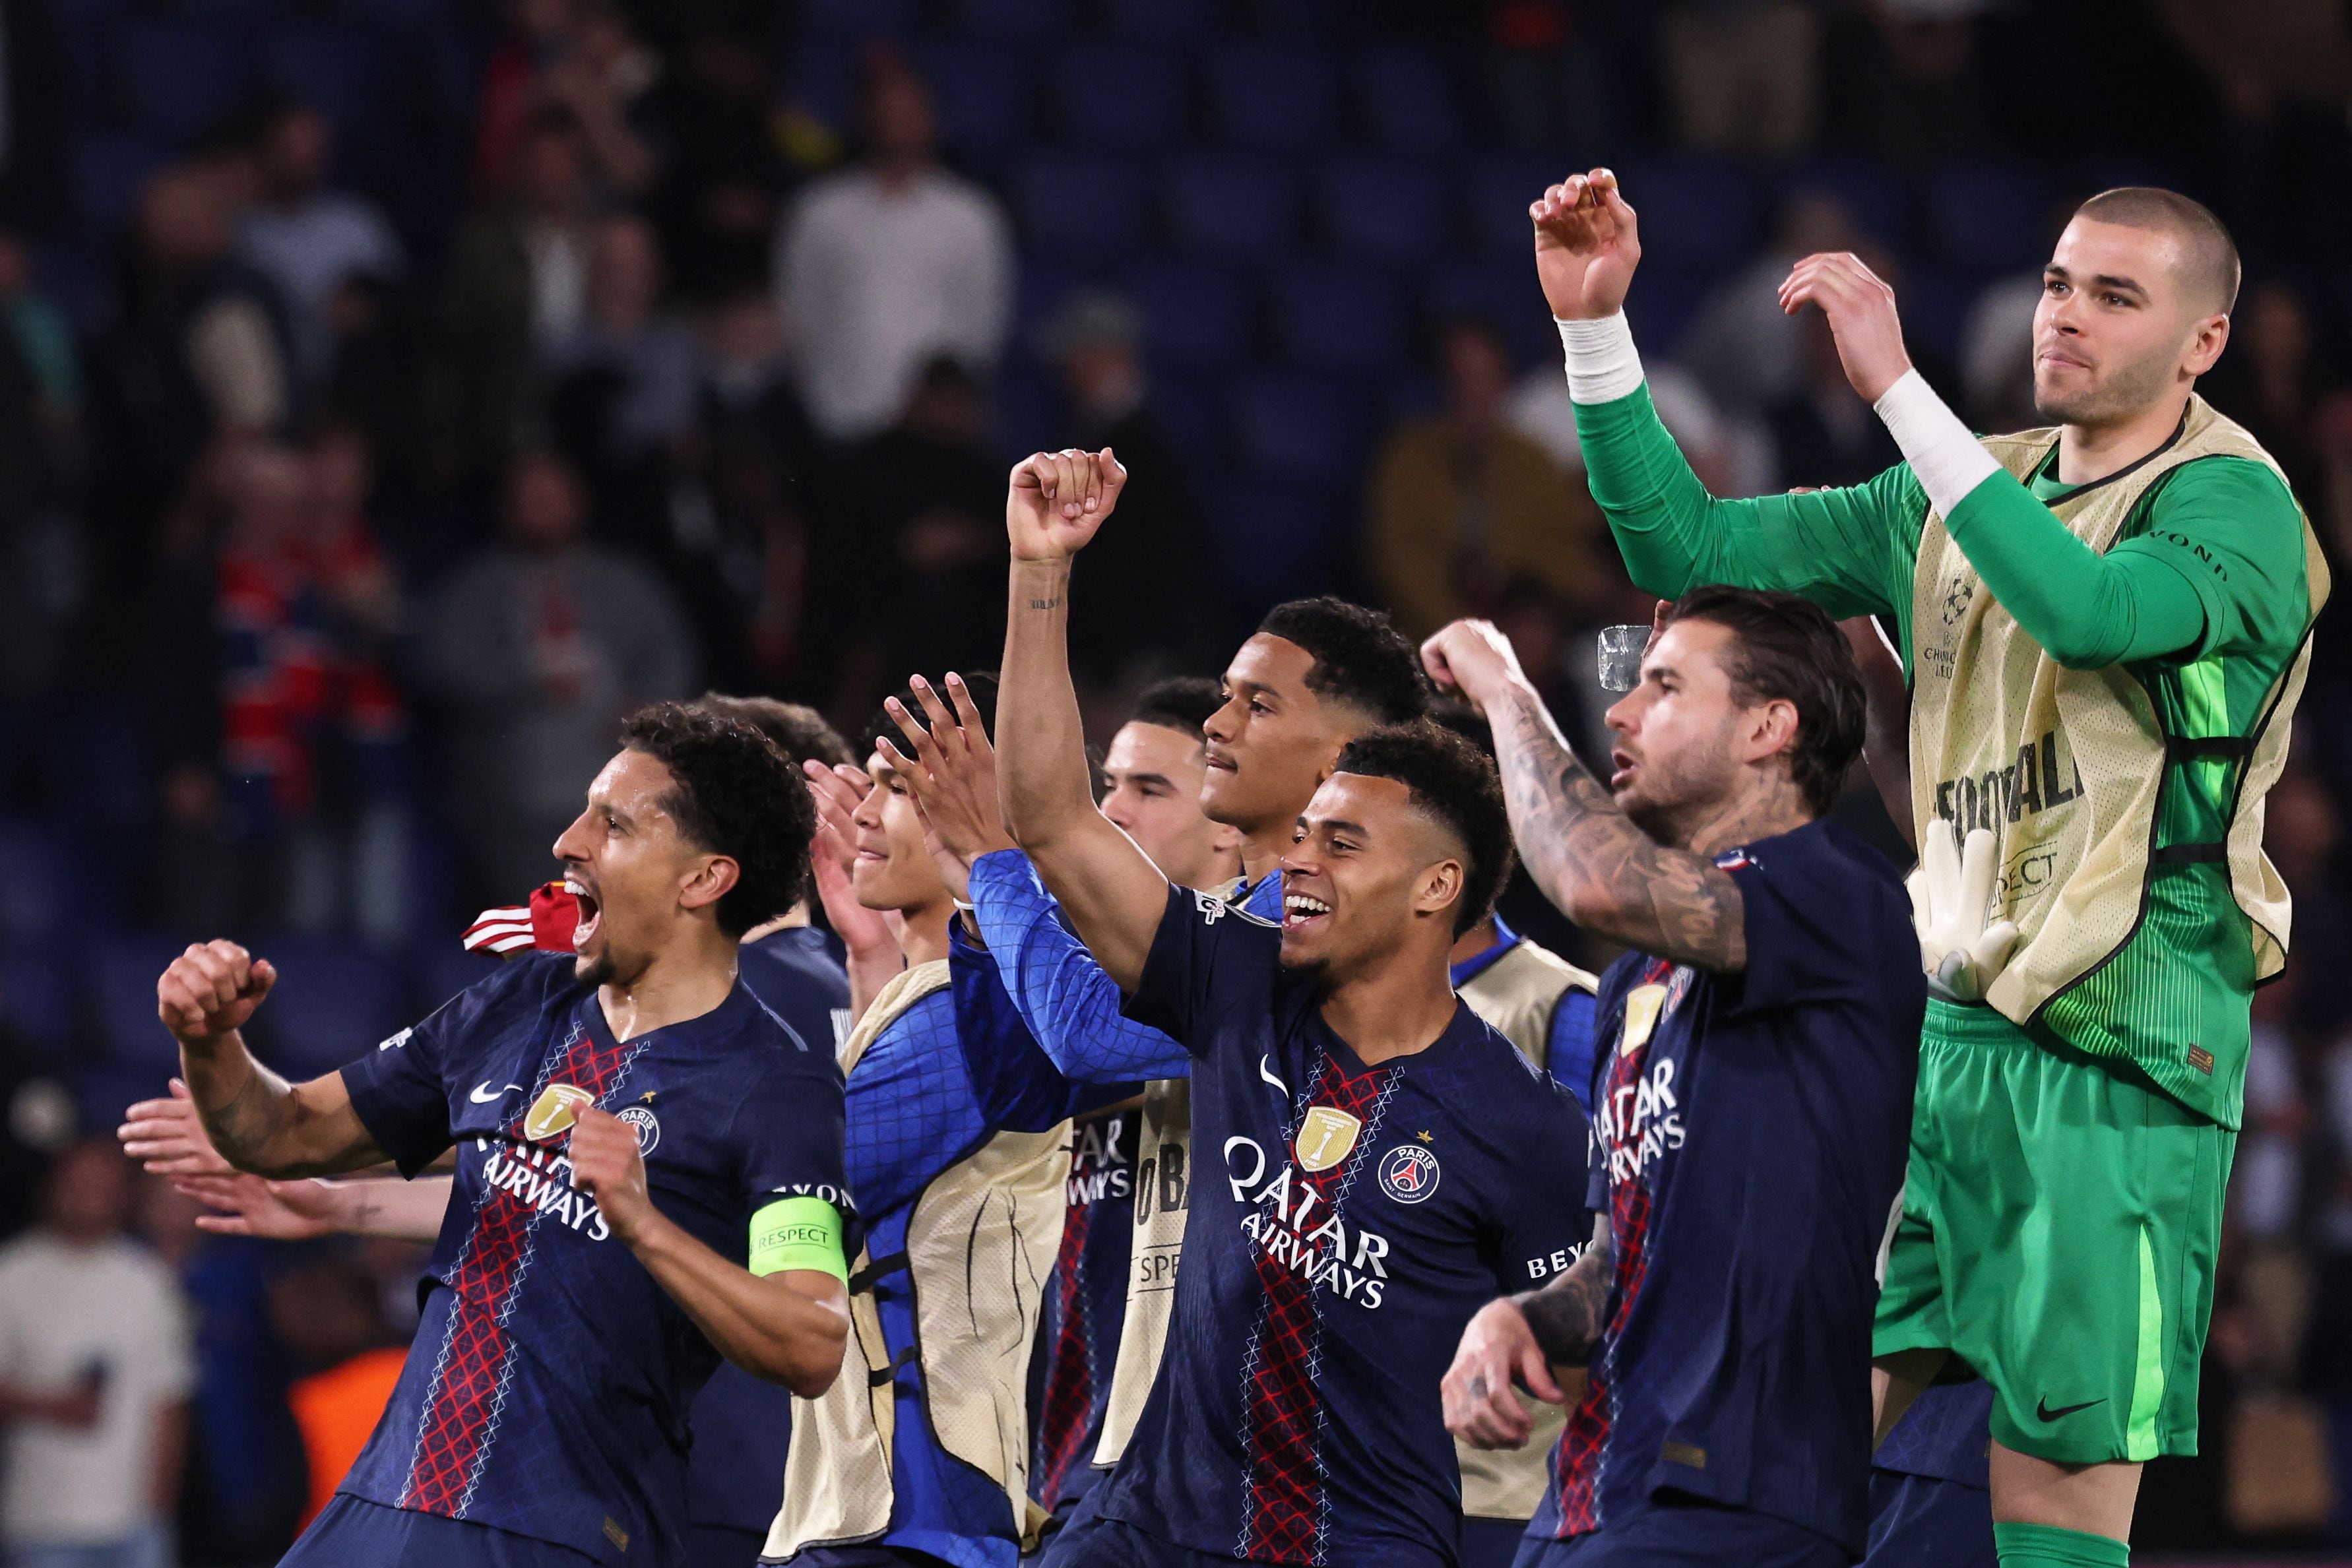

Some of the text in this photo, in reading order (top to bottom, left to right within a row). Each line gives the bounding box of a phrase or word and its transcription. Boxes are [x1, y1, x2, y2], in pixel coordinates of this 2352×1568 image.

[621, 1111, 654, 1130] PARIS
[1397, 1148, 1435, 1170] PARIS
[482, 1150, 610, 1241] AIRWAYS
[1224, 1136, 1389, 1278] QATAR
[759, 1228, 829, 1249] RESPECT
[1240, 1212, 1385, 1309] AIRWAYS
